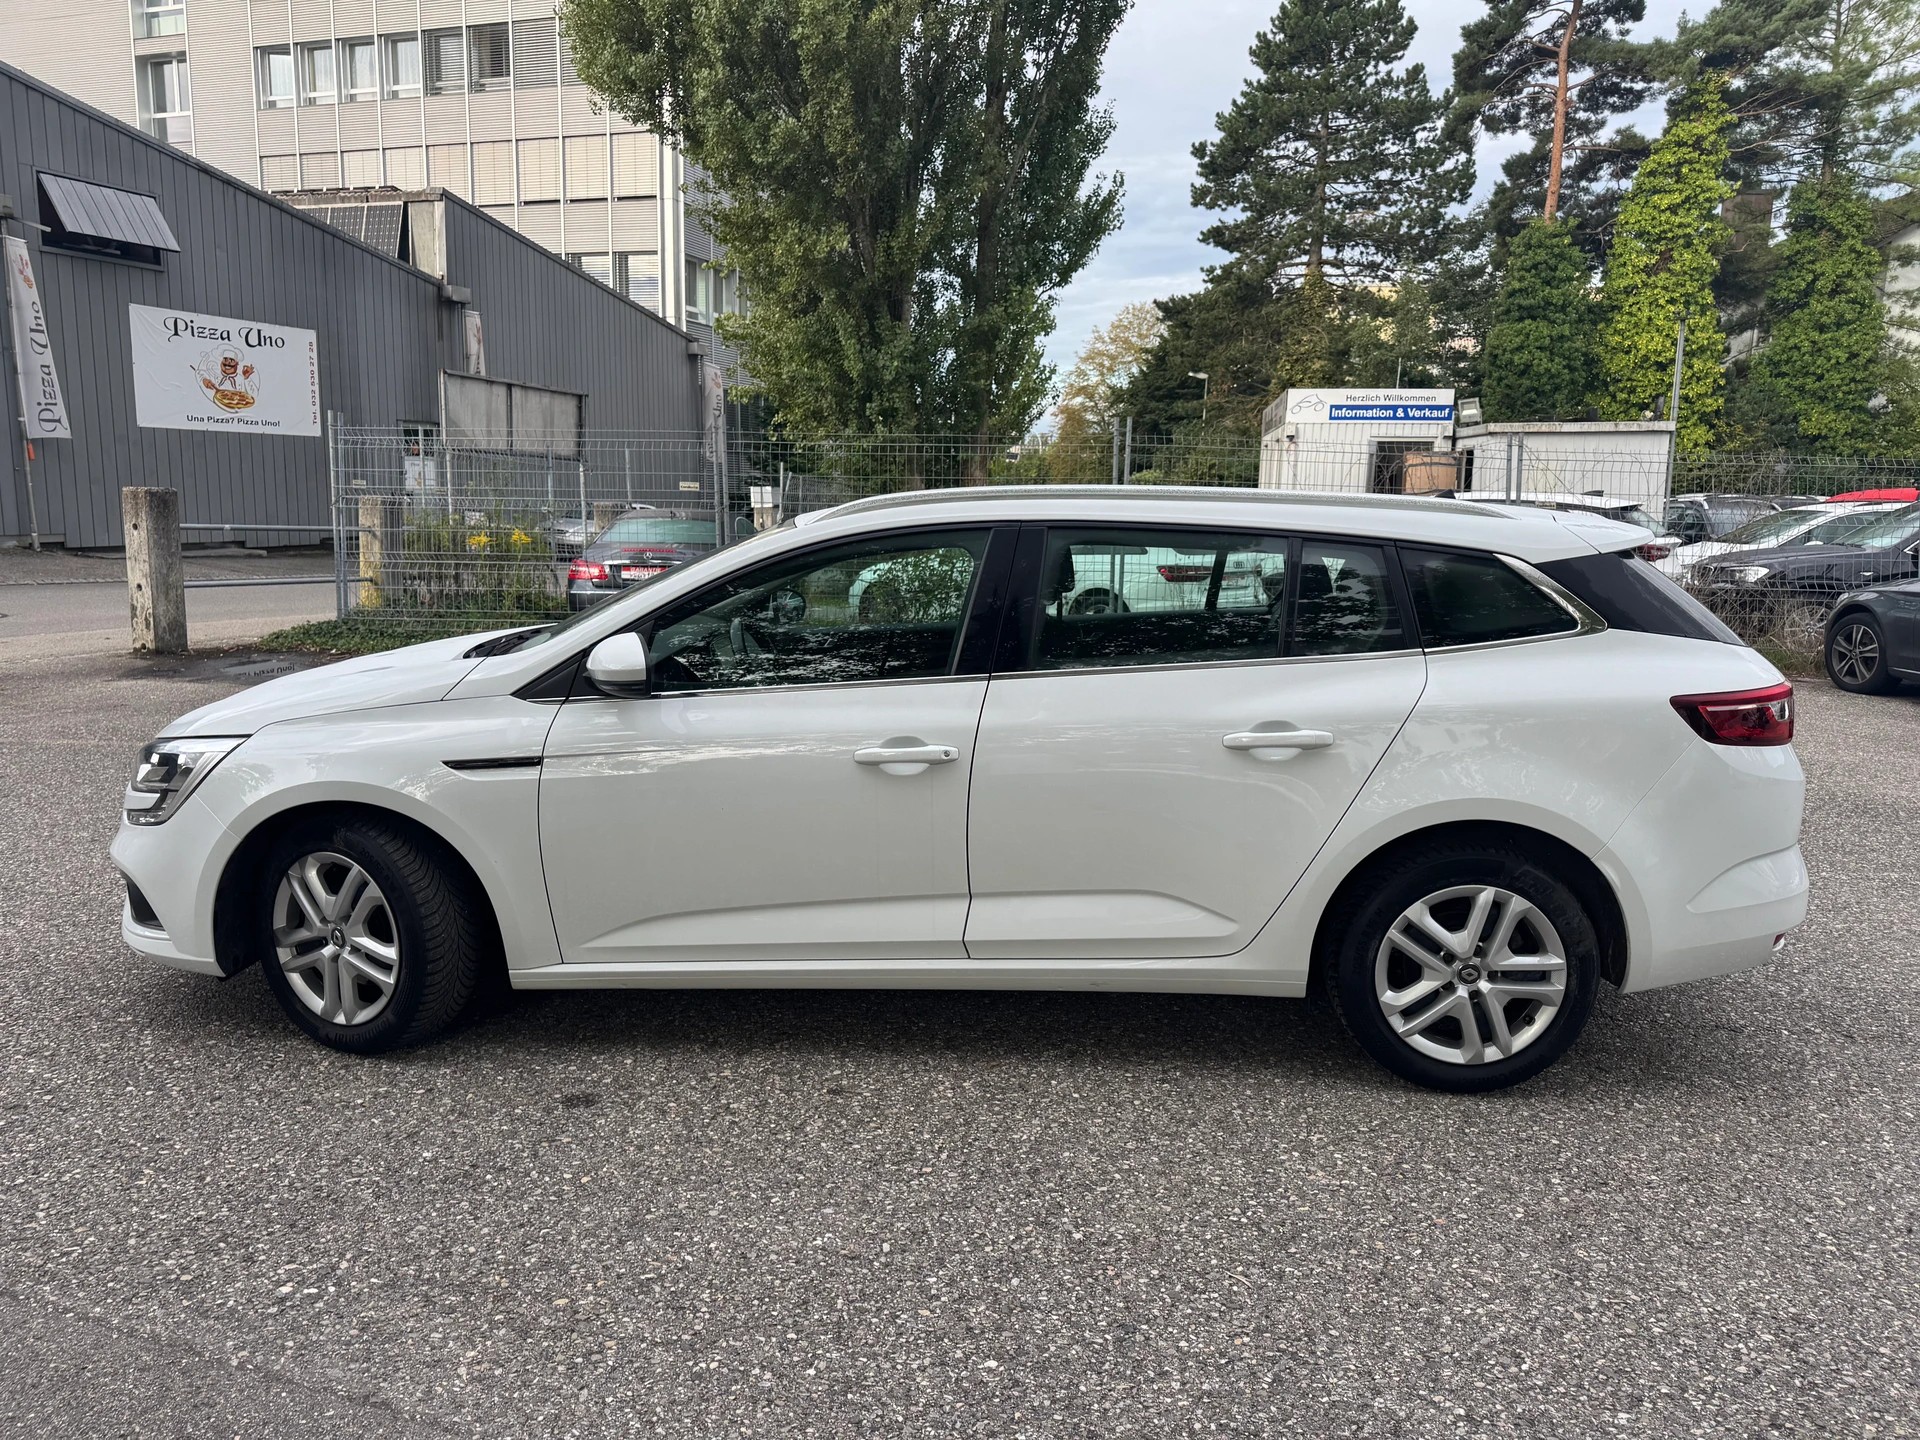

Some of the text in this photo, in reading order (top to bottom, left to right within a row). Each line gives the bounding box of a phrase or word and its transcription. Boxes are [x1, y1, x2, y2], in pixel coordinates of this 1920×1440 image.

[163, 316, 285, 349] Pizza Uno
[308, 341, 314, 353] 28
[29, 301, 68, 432] Pizza Uno
[308, 355, 315, 367] 27
[1345, 394, 1437, 402] Herzlich Willkommen
[1331, 407, 1450, 418] Information & Verkauf
[186, 414, 280, 427] Una Pizza? Pizza Uno!
